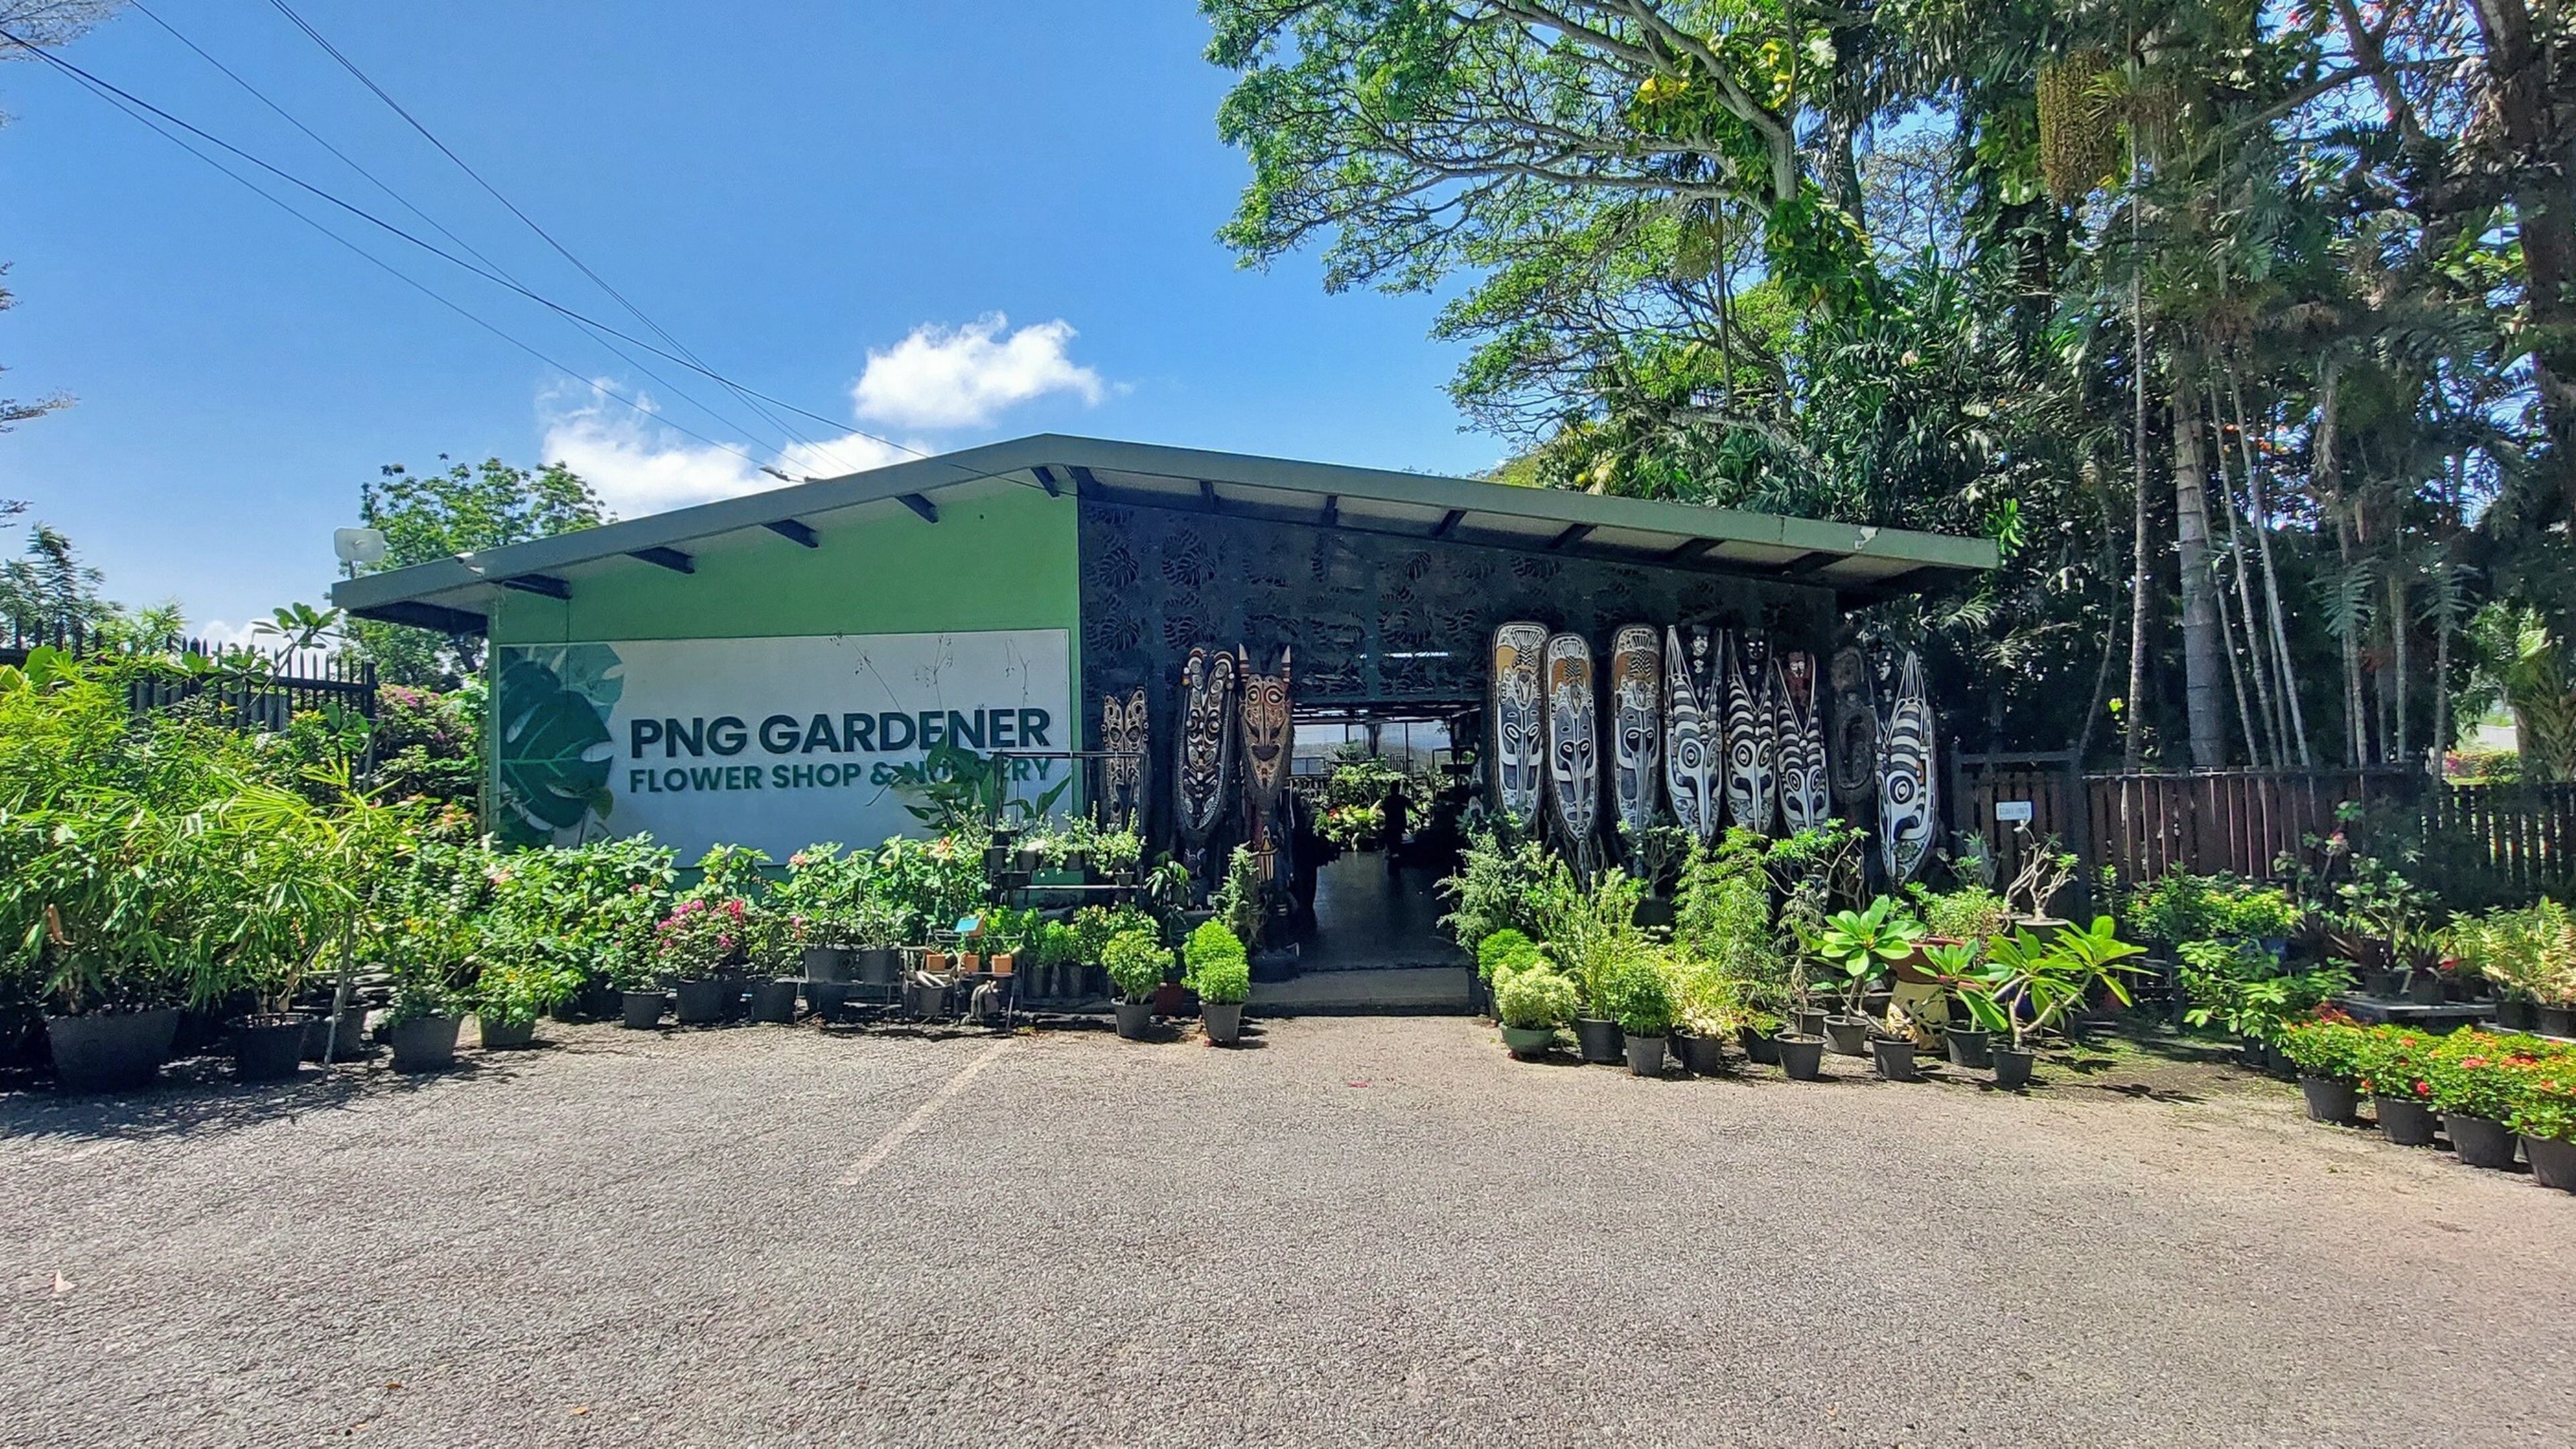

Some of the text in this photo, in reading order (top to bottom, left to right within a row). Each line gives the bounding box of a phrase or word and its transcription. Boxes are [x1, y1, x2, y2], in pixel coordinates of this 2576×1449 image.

[631, 708, 1051, 758] PNG GARDENER
[630, 765, 761, 793] FLOWER
[771, 763, 861, 788] SHOP
[870, 761, 896, 786] &
